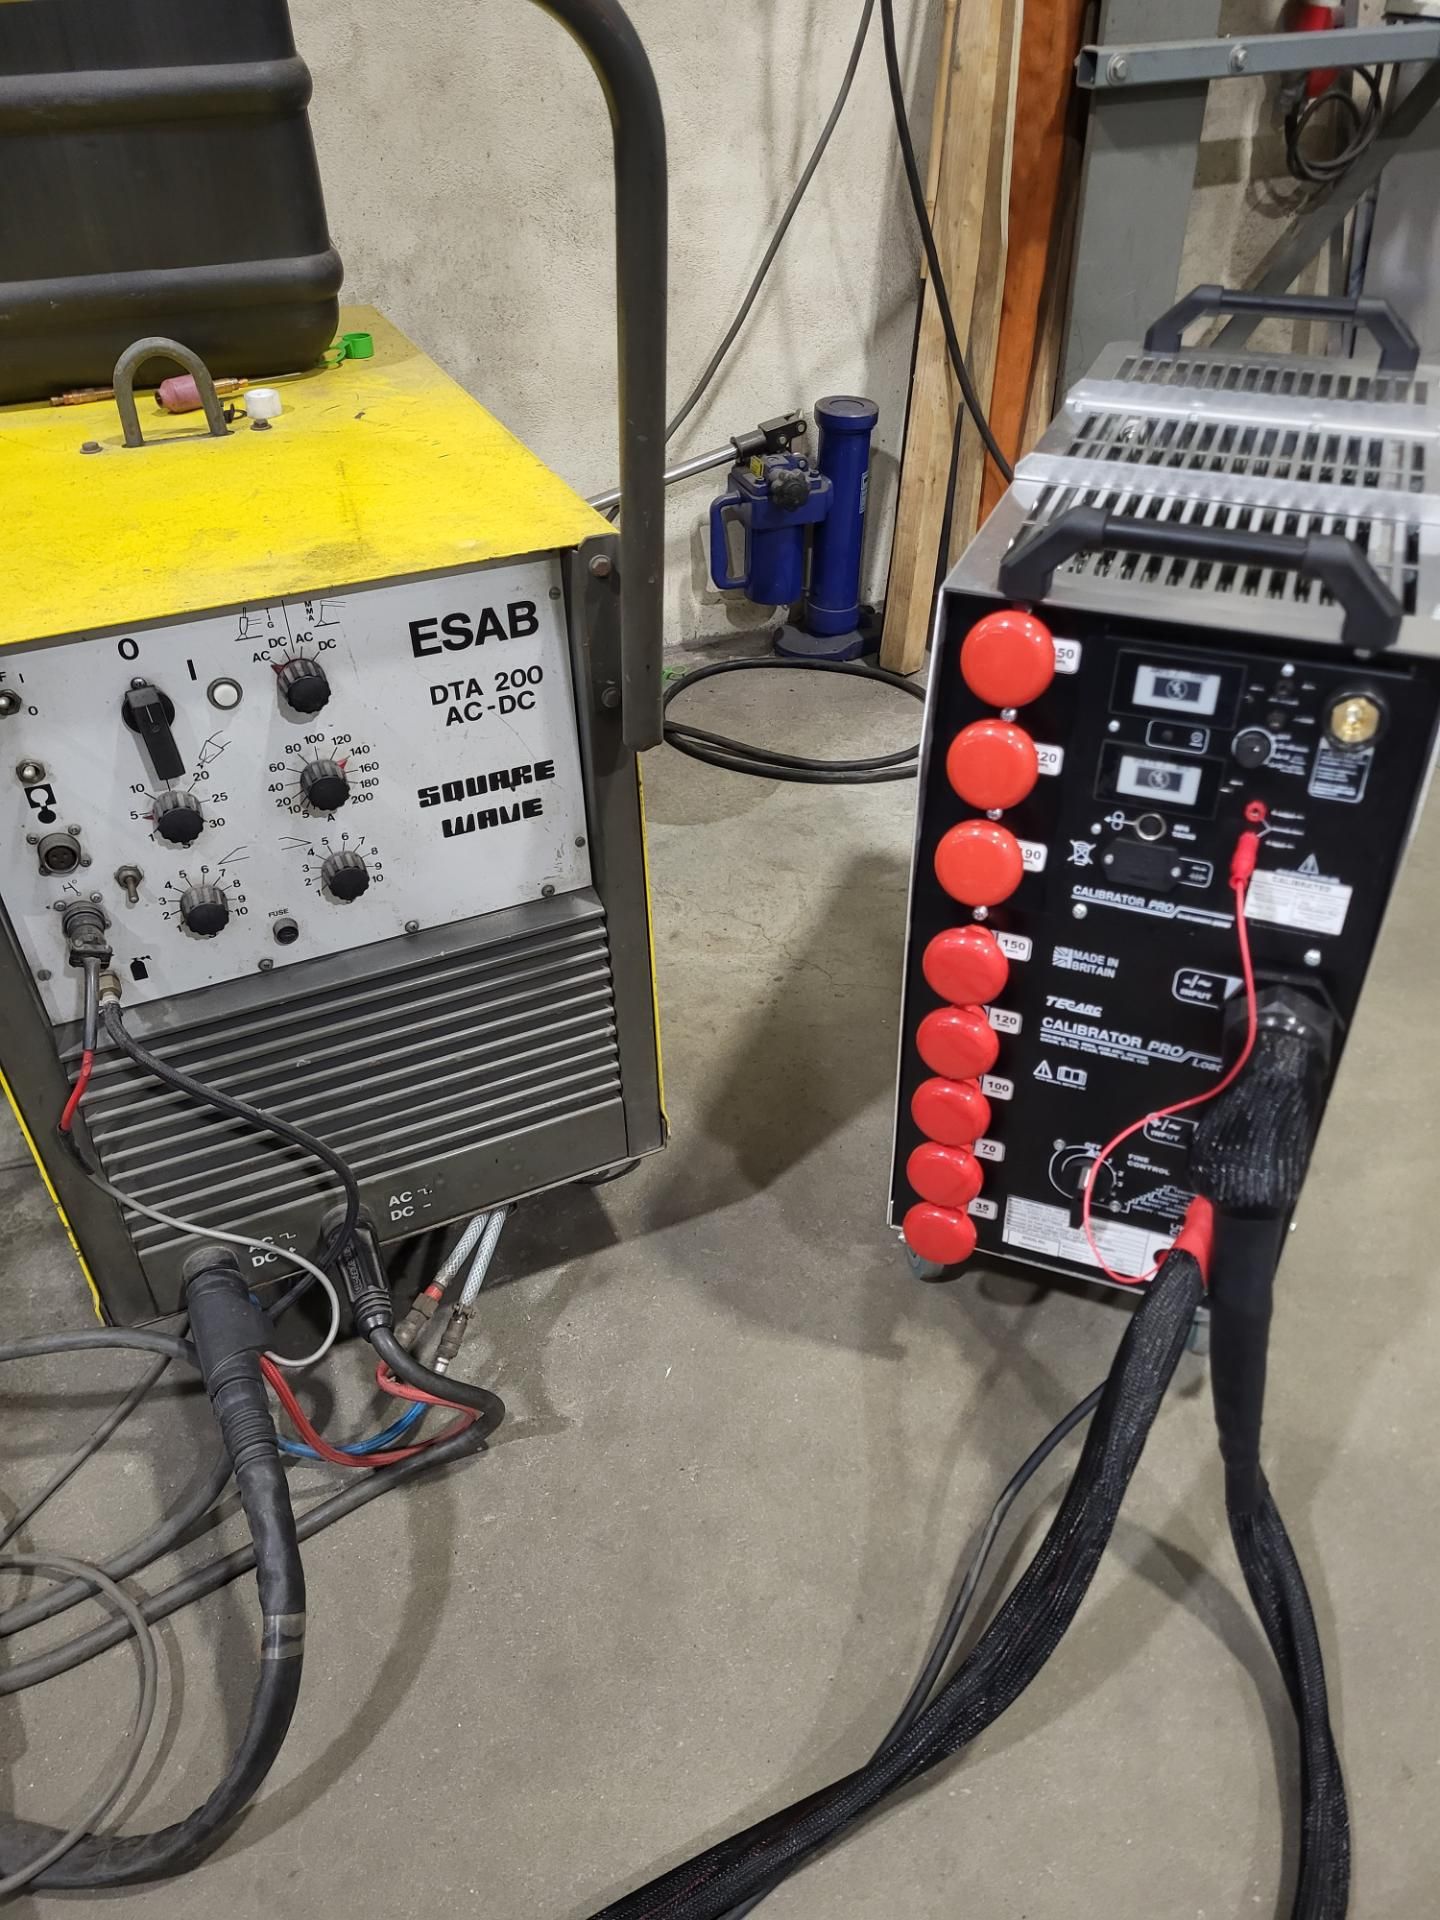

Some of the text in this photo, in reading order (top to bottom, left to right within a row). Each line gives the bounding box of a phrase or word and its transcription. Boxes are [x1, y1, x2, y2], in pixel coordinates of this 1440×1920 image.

[409, 600, 539, 657] ESAB
[268, 636, 287, 649] DC
[295, 631, 313, 644] AC
[318, 638, 337, 651] DC
[252, 650, 271, 663] AC
[429, 665, 543, 705] DTA 200
[446, 690, 536, 726] AC-DC
[303, 733, 325, 745] 100
[331, 733, 352, 746] 120
[285, 743, 302, 754] 80
[350, 744, 370, 756] 140
[269, 761, 285, 772] 60
[359, 761, 379, 773] 160
[192, 770, 210, 782] 20
[129, 783, 145, 794] 10
[268, 782, 284, 792] 40
[359, 777, 379, 789] 180
[417, 760, 555, 808] SQUARE
[211, 792, 228, 803] 25
[275, 796, 292, 808] 20
[350, 792, 374, 805] 200
[130, 810, 139, 820] 5
[287, 804, 301, 815] 10
[302, 809, 310, 819] 5
[208, 817, 226, 829] 30
[327, 813, 336, 822] A
[441, 798, 543, 838] WAVE
[148, 833, 155, 842] 1
[321, 837, 329, 846] 5
[341, 832, 349, 841] 6
[358, 836, 366, 845] 7
[307, 847, 315, 857] 4
[371, 847, 379, 855] 8
[200, 865, 209, 874] 6
[302, 864, 310, 873] 3
[374, 861, 382, 870] 9
[178, 869, 187, 879] 5
[219, 868, 226, 877] 7
[232, 879, 241, 888] 8
[304, 878, 312, 887] 2
[371, 874, 384, 883] 10
[164, 880, 173, 889] 4
[237, 894, 246, 903] 9
[315, 889, 322, 897] 1
[158, 896, 167, 906] 3
[1073, 885, 1175, 914] CALIBRATOR PRO
[162, 911, 171, 920] 2
[234, 906, 248, 917] 10
[268, 908, 289, 918] FUSE
[176, 924, 183, 933] 1
[1003, 939, 1026, 951] 150
[1073, 949, 1119, 969] MADE IN
[1072, 960, 1116, 979] BRITAIN
[1046, 995, 1103, 1018] TECARC
[995, 1014, 1017, 1025] 120
[1041, 1016, 1143, 1049] CALIBRATOR
[1147, 1039, 1184, 1057] PRO
[988, 1081, 1009, 1092] 100
[982, 1143, 996, 1153] 70
[1126, 1161, 1171, 1176] CONTROL
[388, 1191, 413, 1207] AC
[976, 1202, 990, 1212] 35
[390, 1206, 415, 1221] DC
[252, 1251, 278, 1267] DC
